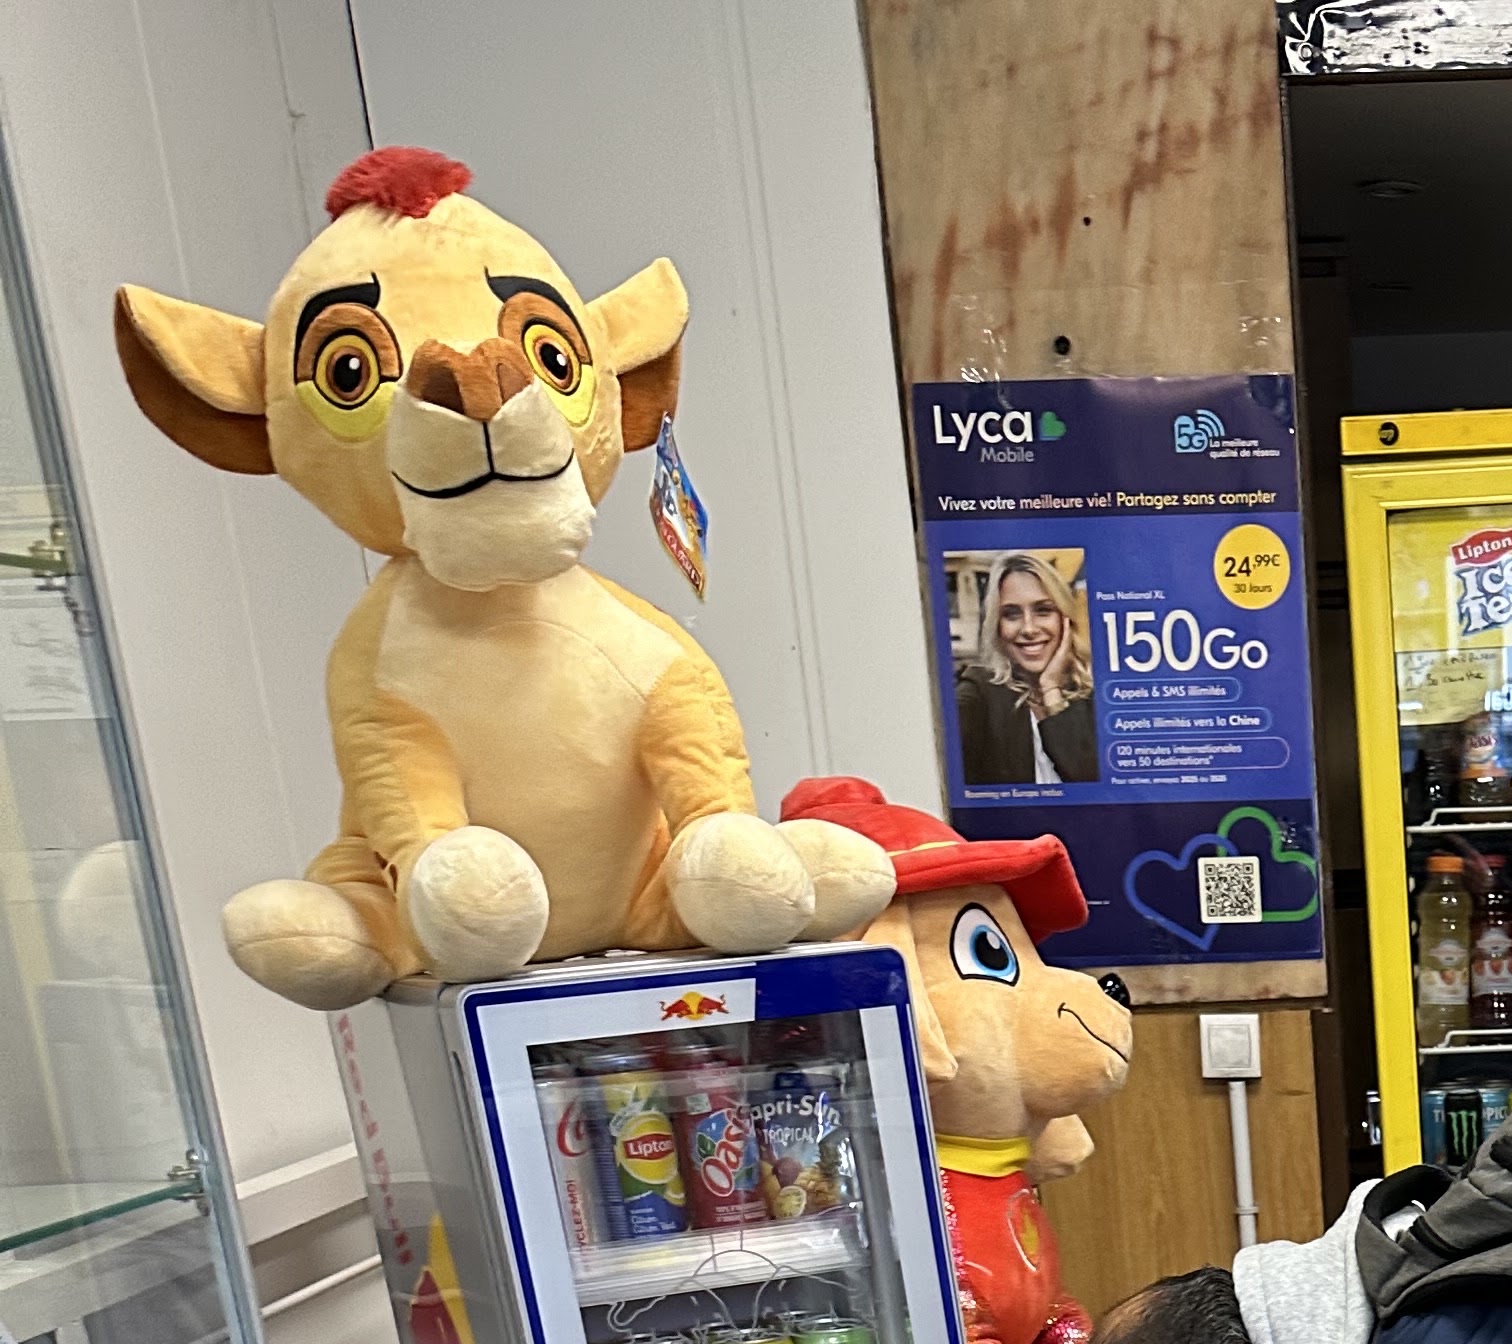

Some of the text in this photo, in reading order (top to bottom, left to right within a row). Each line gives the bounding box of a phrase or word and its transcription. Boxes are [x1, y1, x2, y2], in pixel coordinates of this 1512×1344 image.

[933, 405, 1034, 452] Lyca
[1177, 424, 1206, 450] 5G
[980, 446, 1035, 464] Mobile
[938, 489, 1277, 511] Vivez votre meilleure vie! Partagez sans compter
[1458, 537, 1512, 560] Lipton
[1113, 684, 1227, 700] Appels & SMS illimités
[1115, 714, 1260, 731] Appels illimités vers la Chine
[1117, 743, 1242, 755] 120 minutes internationales
[1118, 758, 1137, 767] vers
[1139, 756, 1152, 767] 50
[750, 1093, 842, 1126] apri-Sun
[763, 1126, 815, 1146] TROPICAL
[565, 1179, 592, 1262] YCLEZ-MOI
